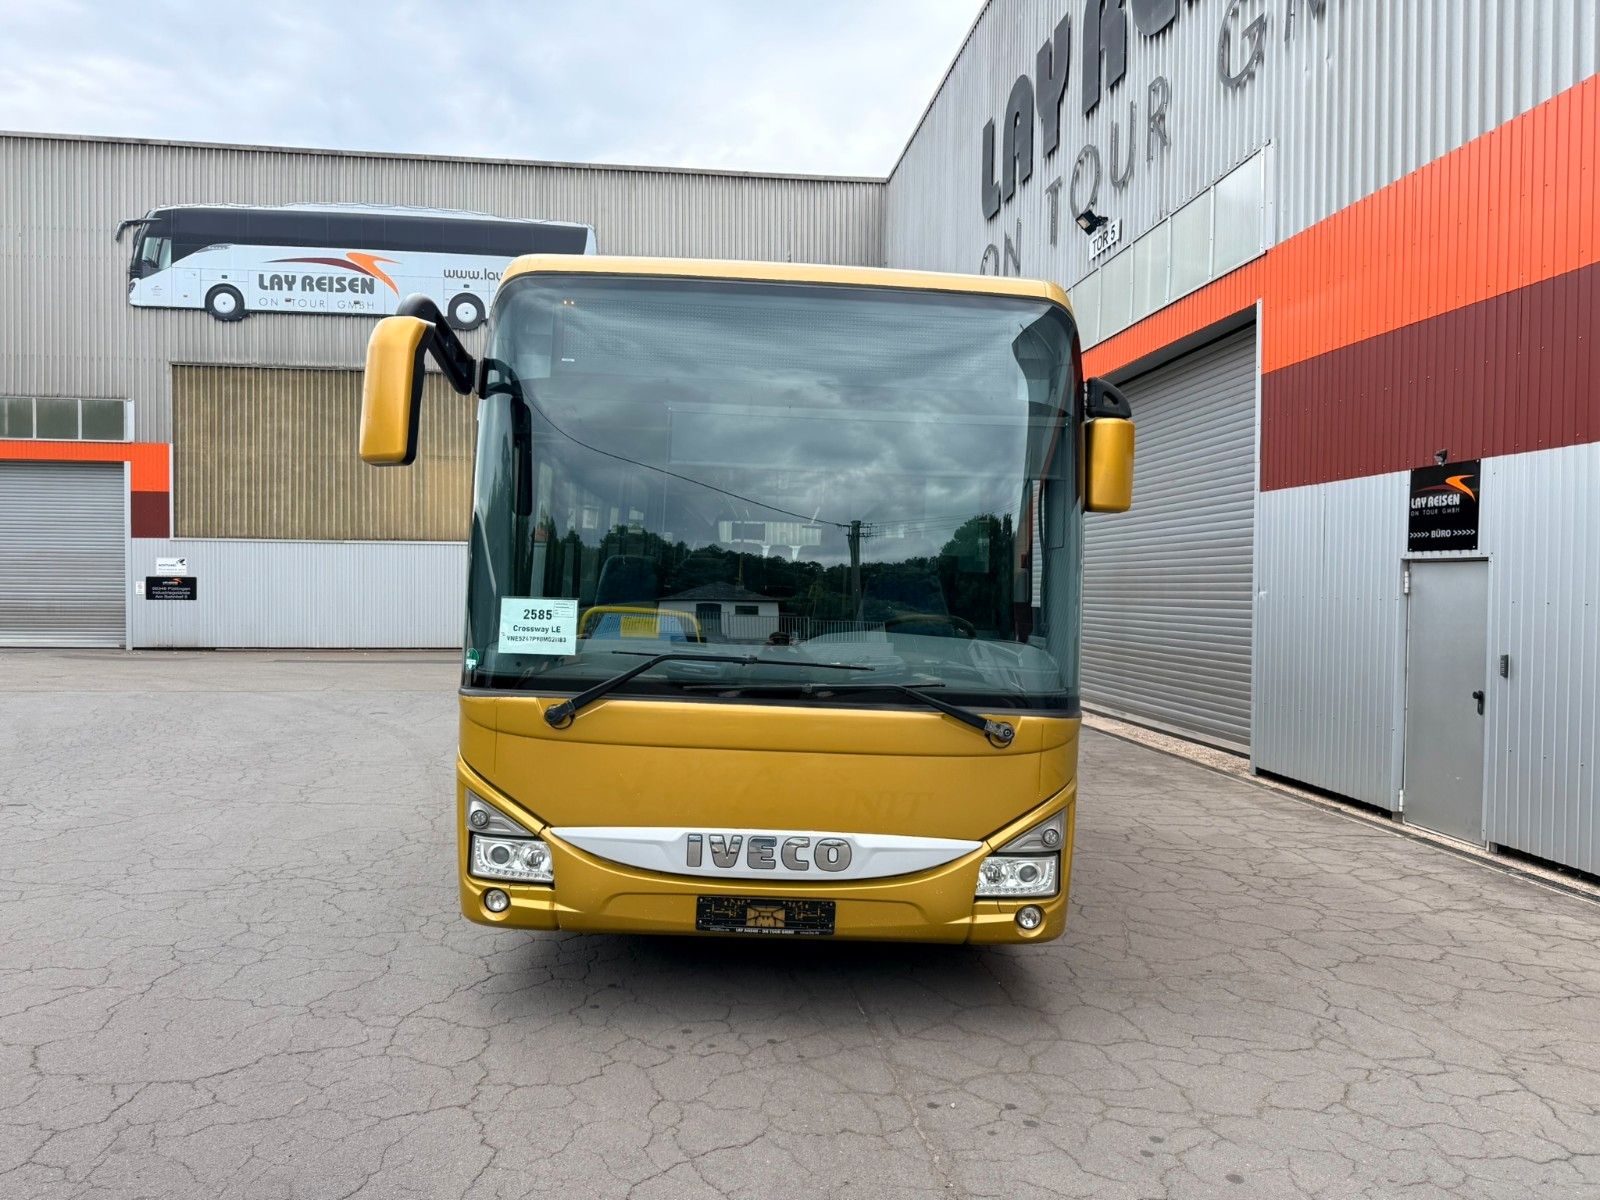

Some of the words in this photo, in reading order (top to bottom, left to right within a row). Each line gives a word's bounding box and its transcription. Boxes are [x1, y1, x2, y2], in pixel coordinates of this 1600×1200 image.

[982, 12, 1070, 220] LAY
[1044, 76, 1169, 247] TOUR
[1093, 230, 1109, 255] TOR
[1110, 224, 1116, 241] 5
[258, 273, 297, 292] LAY
[301, 275, 375, 295] REISEN
[258, 297, 279, 307] ON
[291, 298, 326, 309] TOUR
[337, 300, 374, 310] GMBH
[1411, 497, 1426, 509] LAY
[1428, 493, 1460, 507] REISEN
[1431, 528, 1451, 538] BÜRO
[523, 609, 553, 620] 2585
[513, 625, 549, 633] Crossway
[686, 833, 852, 872] IVECO
